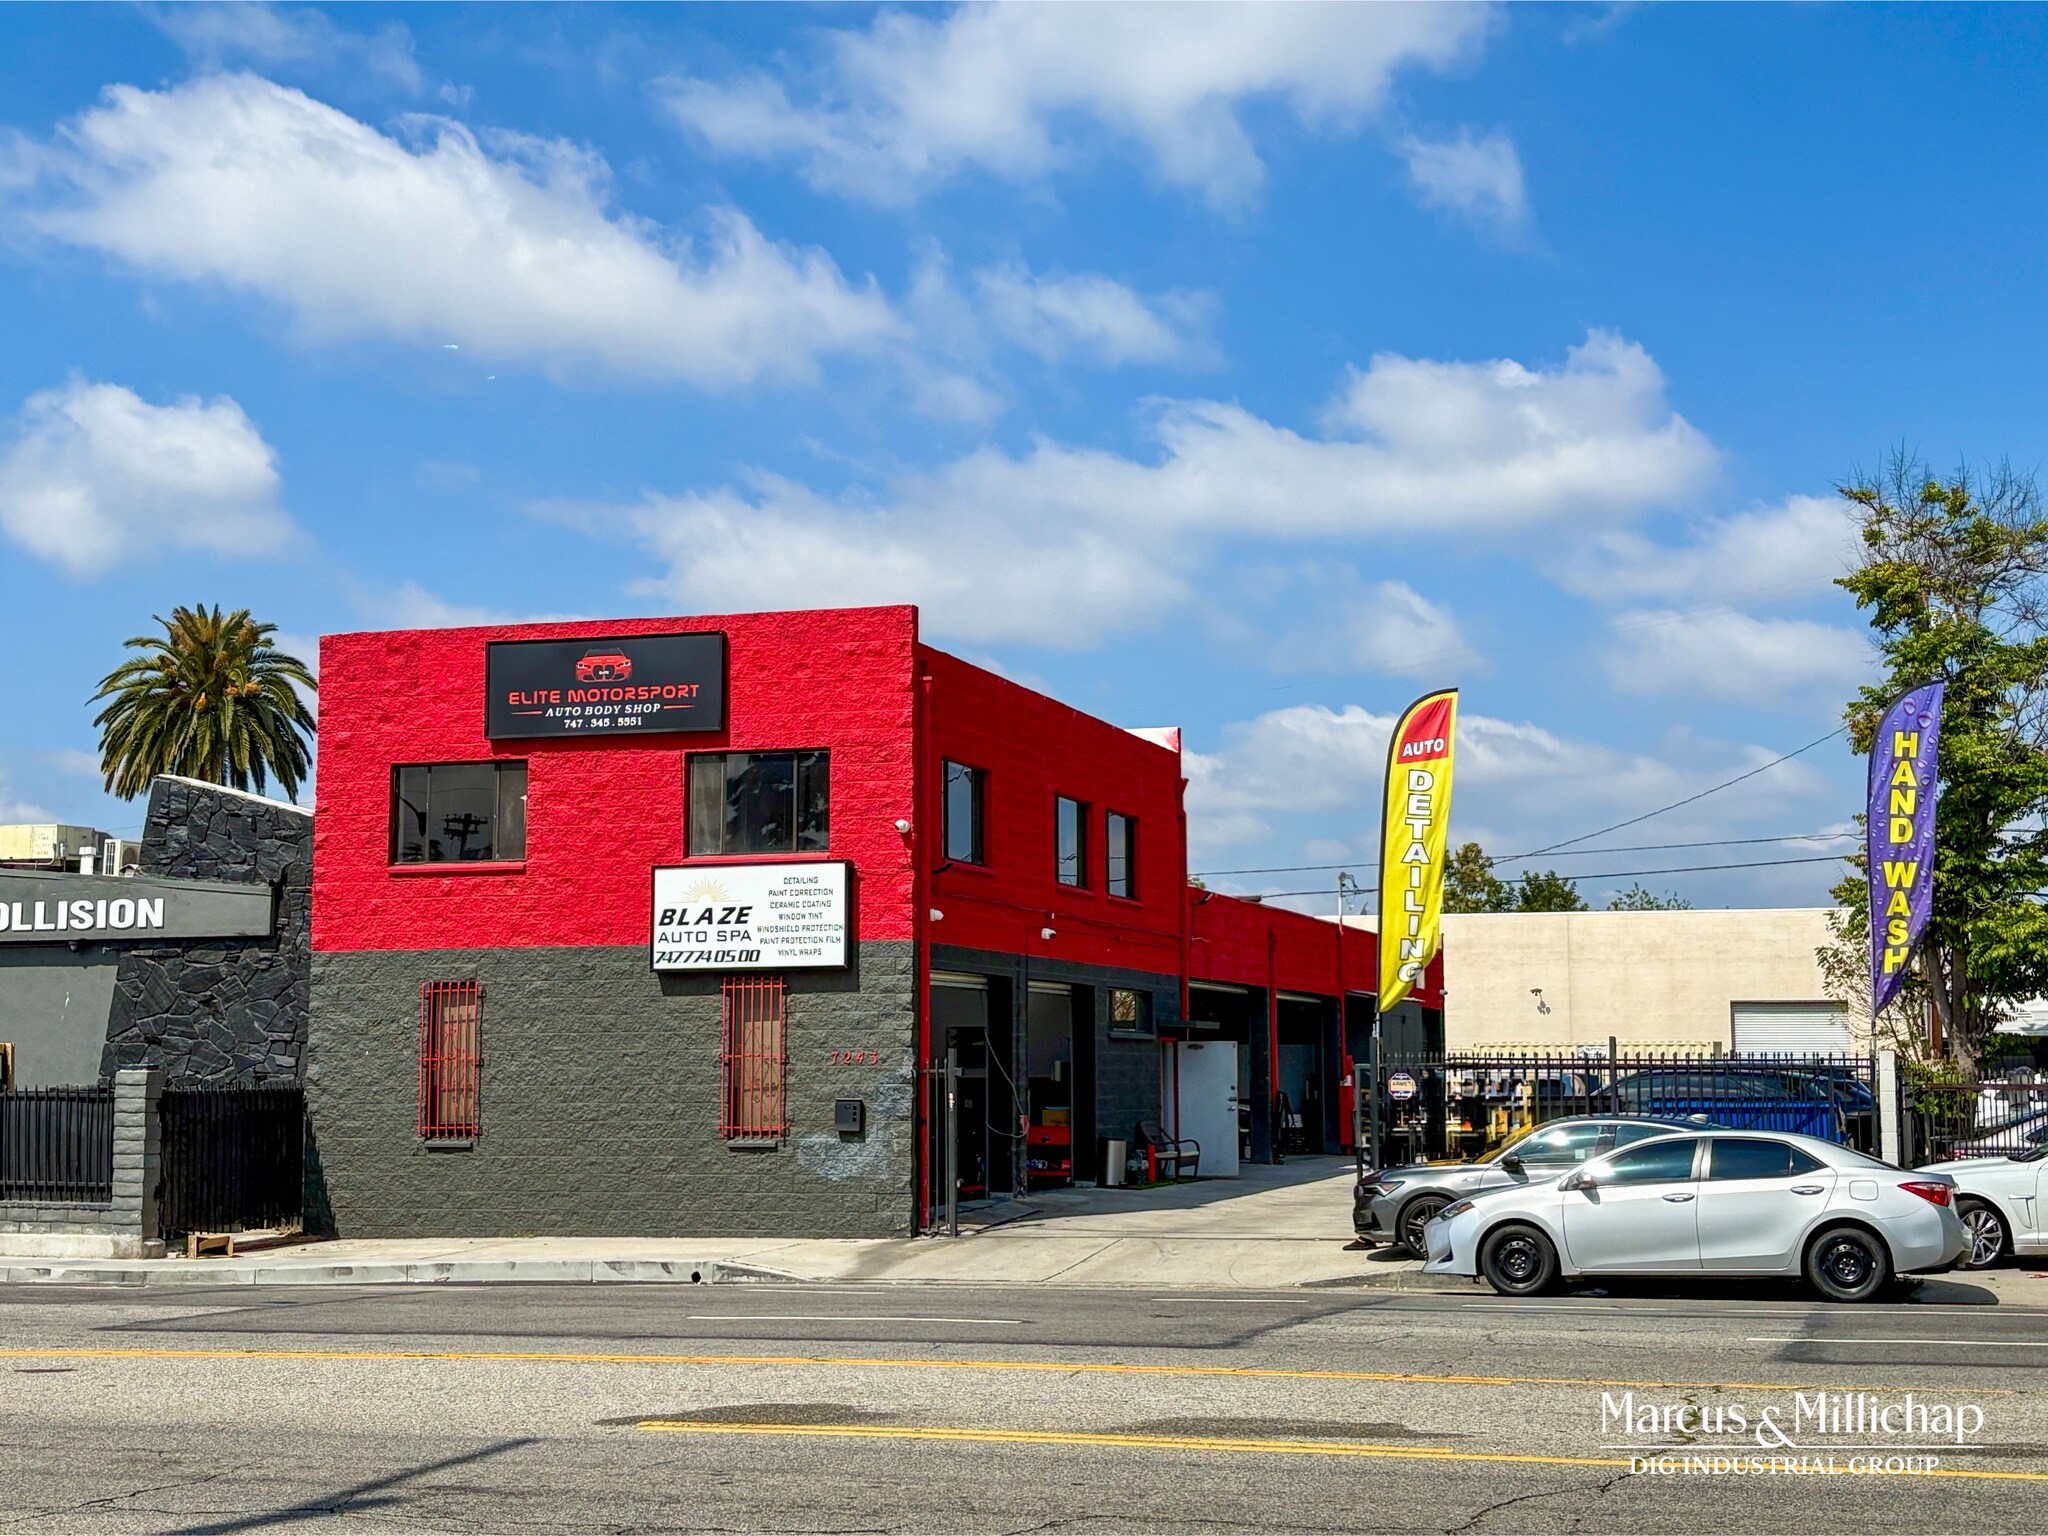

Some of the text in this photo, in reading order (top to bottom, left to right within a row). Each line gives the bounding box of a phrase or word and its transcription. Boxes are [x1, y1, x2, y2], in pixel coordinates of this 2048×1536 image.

[508, 684, 699, 705] ELITE MOTORSPORT
[545, 703, 661, 717] AUTO BODY SHOP
[1402, 737, 1445, 757] AUTO
[1882, 731, 1918, 974] HAND WASH
[783, 876, 819, 885] DETAILING
[1397, 769, 1433, 984] DETAILING
[768, 888, 834, 897] PAINT CORRECTION
[770, 900, 832, 909] CERAMIC COATING
[658, 906, 753, 926] BLAZE
[778, 912, 823, 921] WINDOW TINT
[757, 924, 844, 933] WINDSHIELD PROTECTION
[658, 930, 752, 943] AUTO SPA
[780, 936, 824, 944] PROTECTION
[825, 935, 841, 943] FILM
[799, 948, 822, 956] WRAPS
[831, 1050, 878, 1065] 7243
